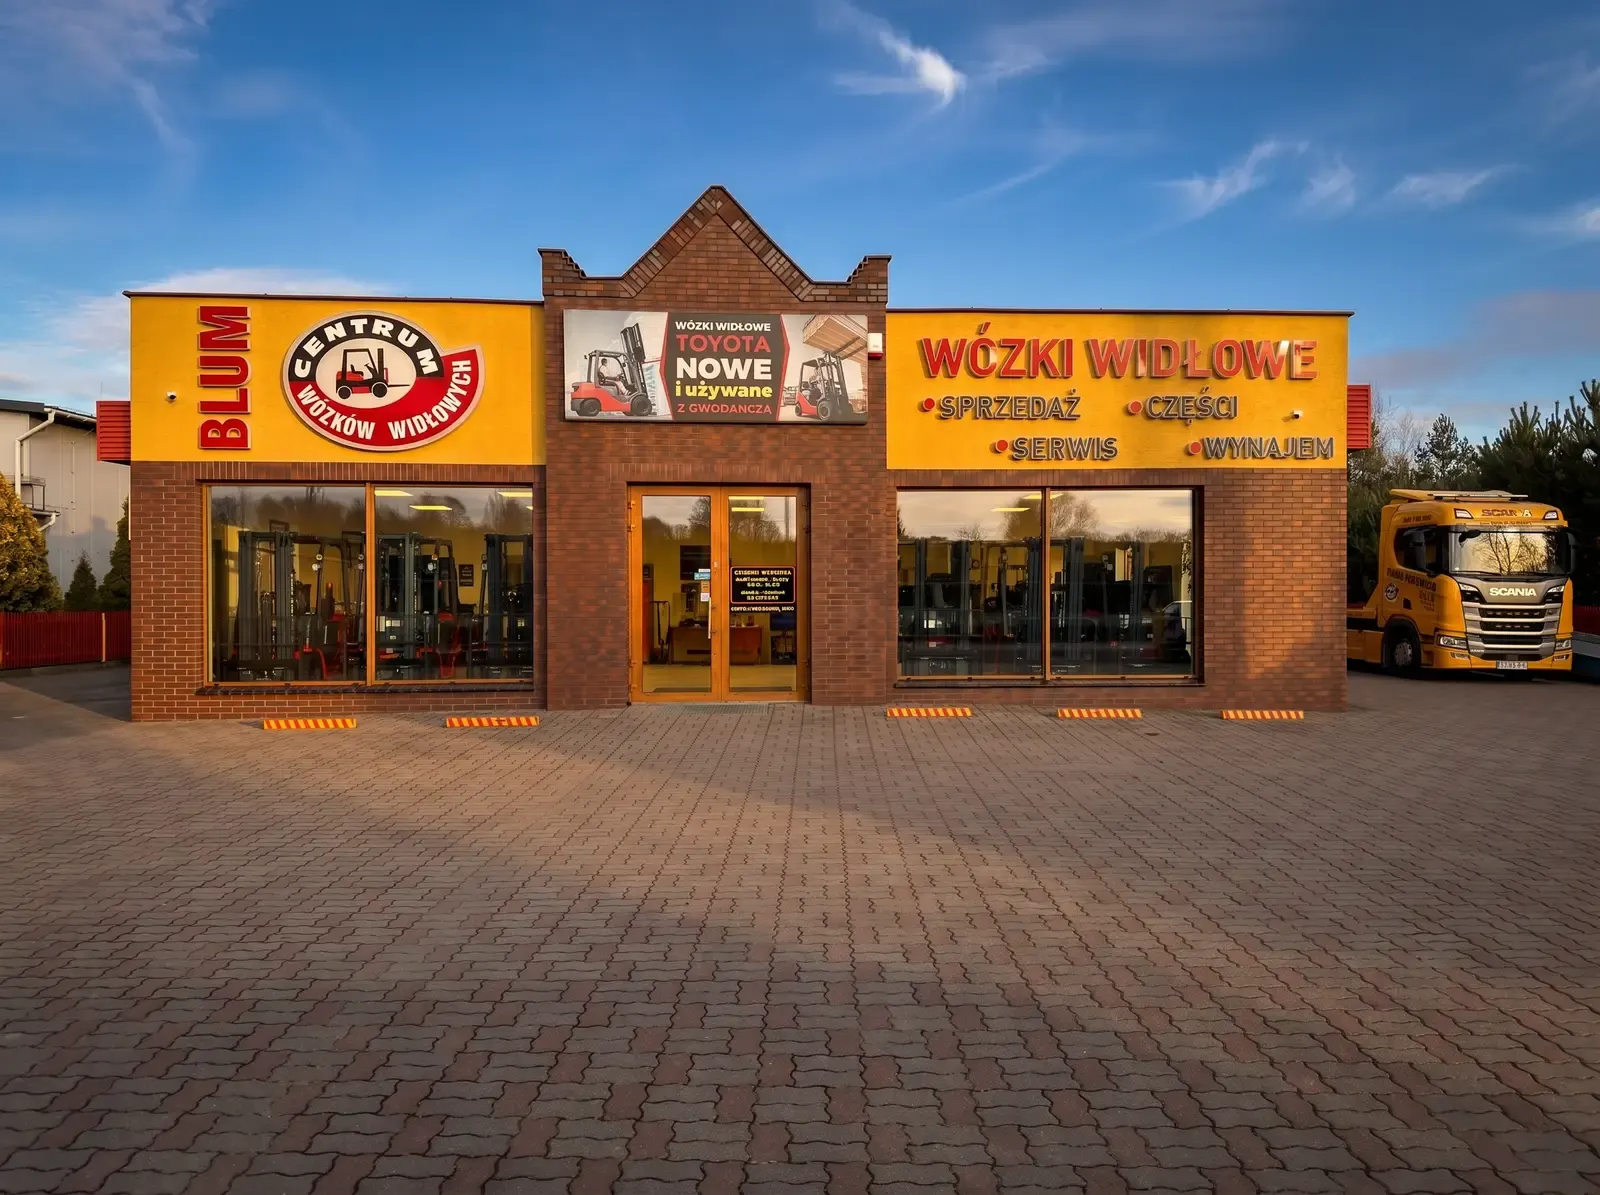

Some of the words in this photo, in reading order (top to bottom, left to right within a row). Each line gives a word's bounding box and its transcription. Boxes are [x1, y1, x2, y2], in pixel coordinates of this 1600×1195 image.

[675, 320, 714, 331] WÓZKI
[715, 321, 771, 332] WIDŁOWE
[294, 318, 439, 378] CENTRUM
[675, 334, 771, 353] TOYOTA
[920, 322, 1073, 378] WÓZKI
[1087, 338, 1318, 379] WIDŁOWE
[199, 305, 251, 449] BLUM
[676, 357, 772, 380] NOWE
[296, 384, 376, 441] WÓZKÓW
[387, 359, 472, 441] WIDŁOWYCH
[675, 380, 681, 397] i
[685, 380, 773, 400] używane
[677, 403, 686, 413] Z
[940, 388, 1081, 420] SPRZEDAŻ
[1145, 387, 1239, 427] CZĘŚCI
[1013, 437, 1118, 460] SERWIS
[1203, 437, 1334, 460] WYNAJEM
[1489, 587, 1537, 597] SCANIA
